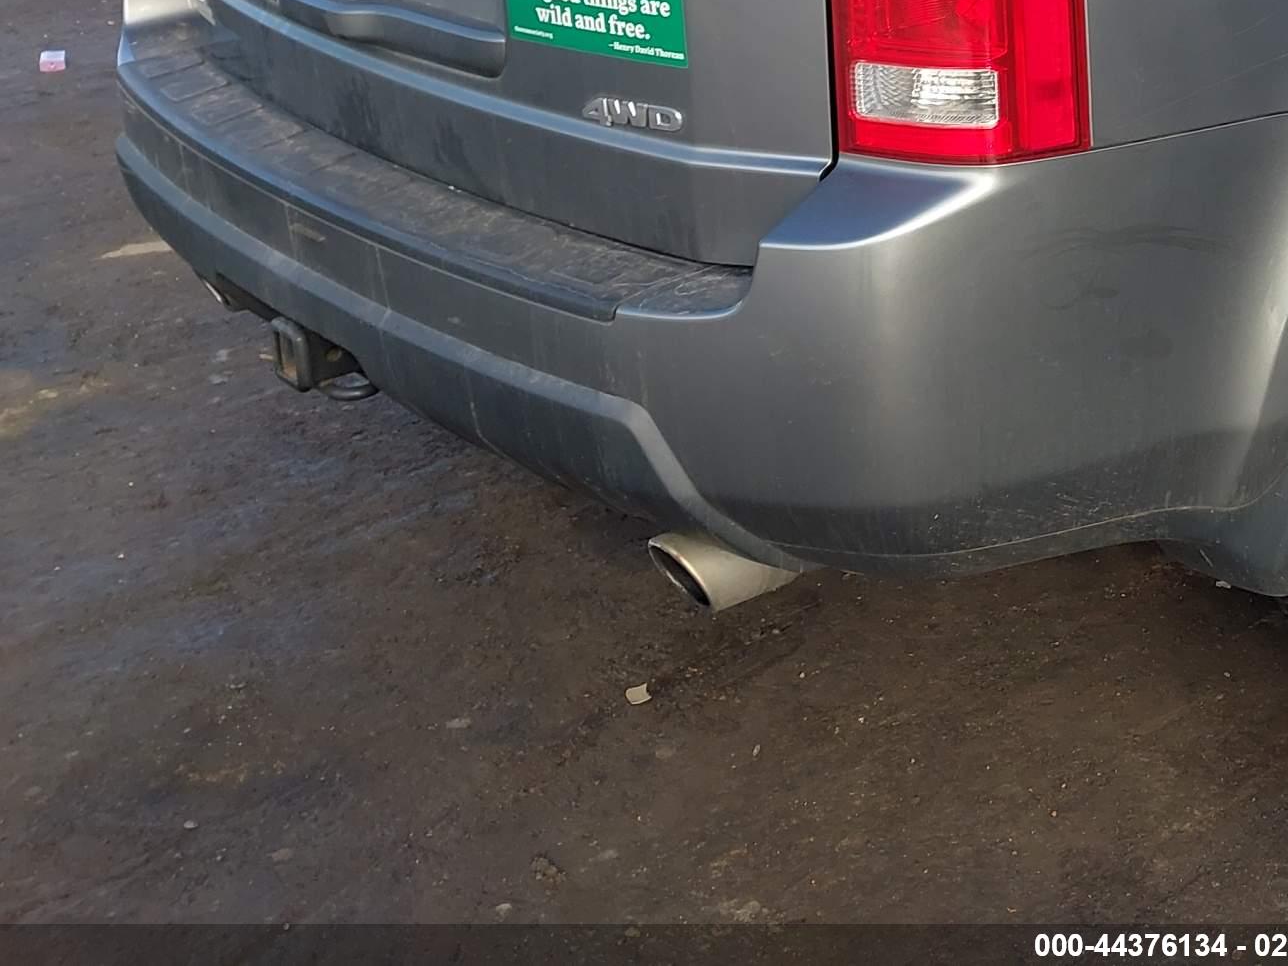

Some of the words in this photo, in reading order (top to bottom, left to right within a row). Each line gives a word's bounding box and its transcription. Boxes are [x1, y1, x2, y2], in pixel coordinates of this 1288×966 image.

[535, 4, 573, 27] wild
[575, 12, 607, 34] and
[608, 14, 651, 40] free.
[635, 44, 655, 56] David
[582, 97, 684, 132] 4WD
